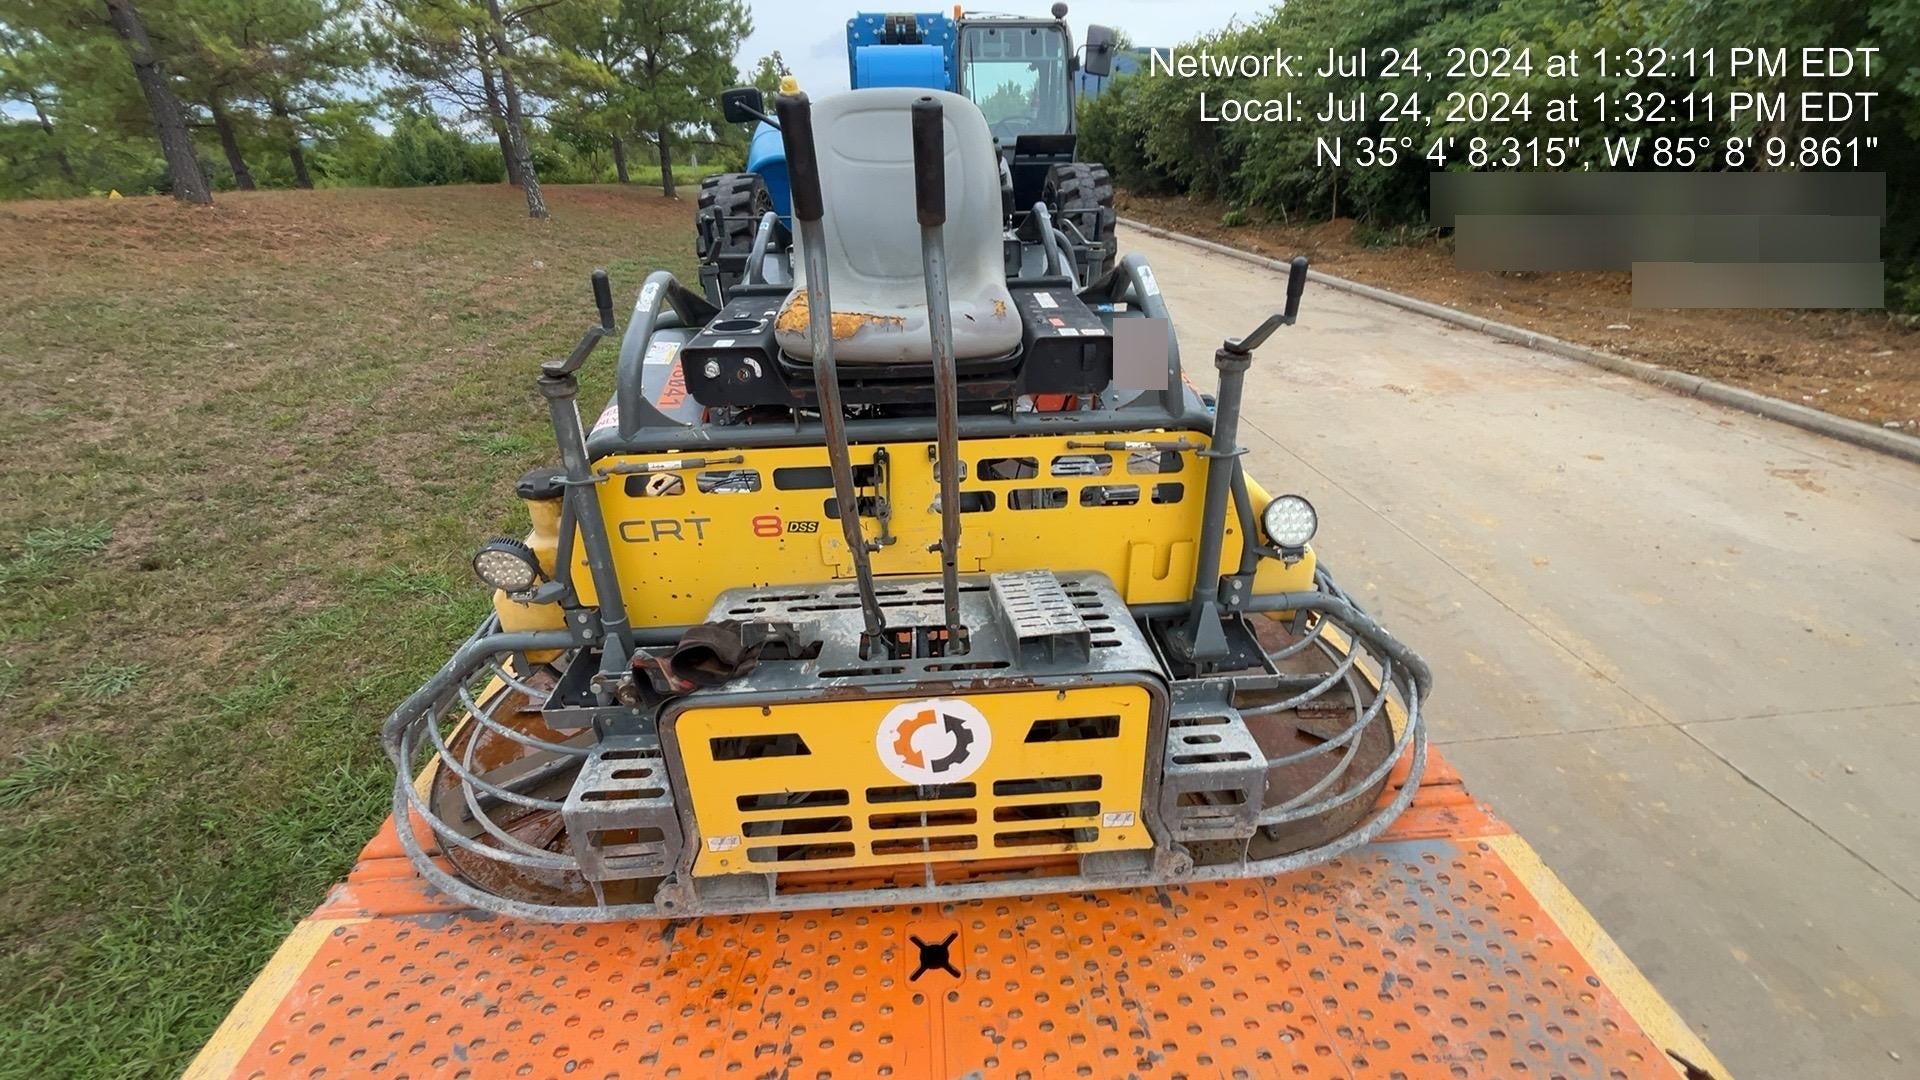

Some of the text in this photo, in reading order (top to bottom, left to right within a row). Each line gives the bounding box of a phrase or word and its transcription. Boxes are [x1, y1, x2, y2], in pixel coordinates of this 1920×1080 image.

[619, 515, 819, 543] CRT 8 DSS
